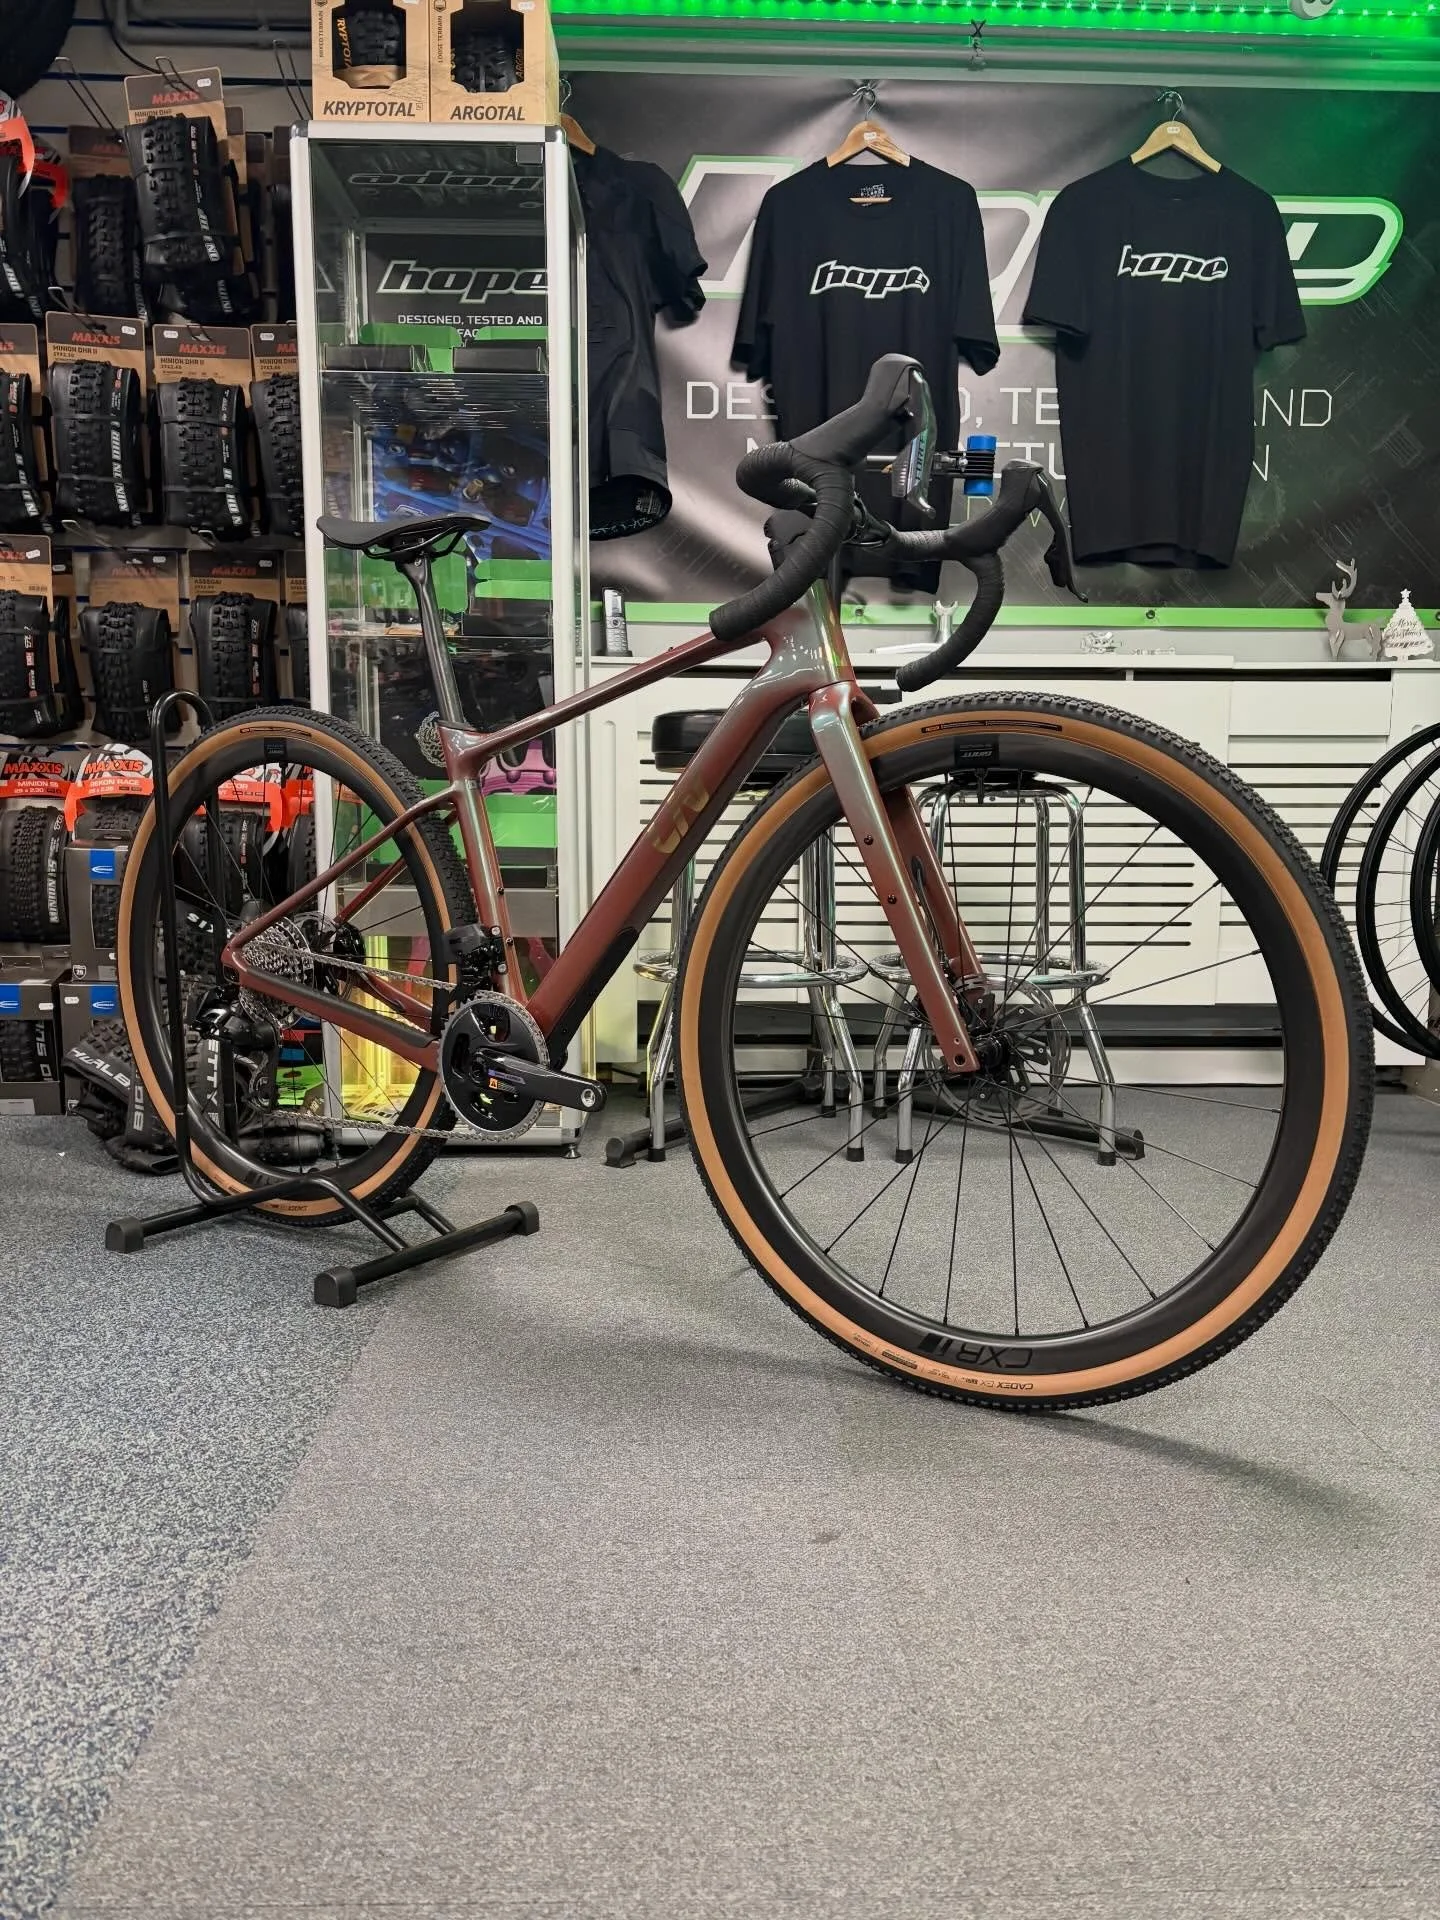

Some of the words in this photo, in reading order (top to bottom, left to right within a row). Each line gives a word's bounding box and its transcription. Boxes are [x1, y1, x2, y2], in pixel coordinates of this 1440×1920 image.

[322, 101, 416, 117] KRYPTOTAL
[450, 105, 526, 121] ARGOTAL
[1117, 244, 1229, 283] hope
[809, 259, 931, 299] hope
[397, 314, 464, 326] DESIGNED,
[467, 315, 514, 326] TESTED
[516, 315, 543, 326] AND
[71, 331, 121, 345] MAXXIS
[53, 344, 78, 354] MINION
[178, 343, 228, 355] MAXXIS
[3, 761, 64, 775] MAXXIS
[85, 759, 144, 775] MAXXIS
[90, 778, 116, 788] REKON
[117, 778, 140, 786] RACE
[47, 881, 60, 923] MINION
[133, 1085, 144, 1132] BIG
[955, 1342, 1033, 1369] CXR
[996, 1382, 1034, 1390] CADEX
